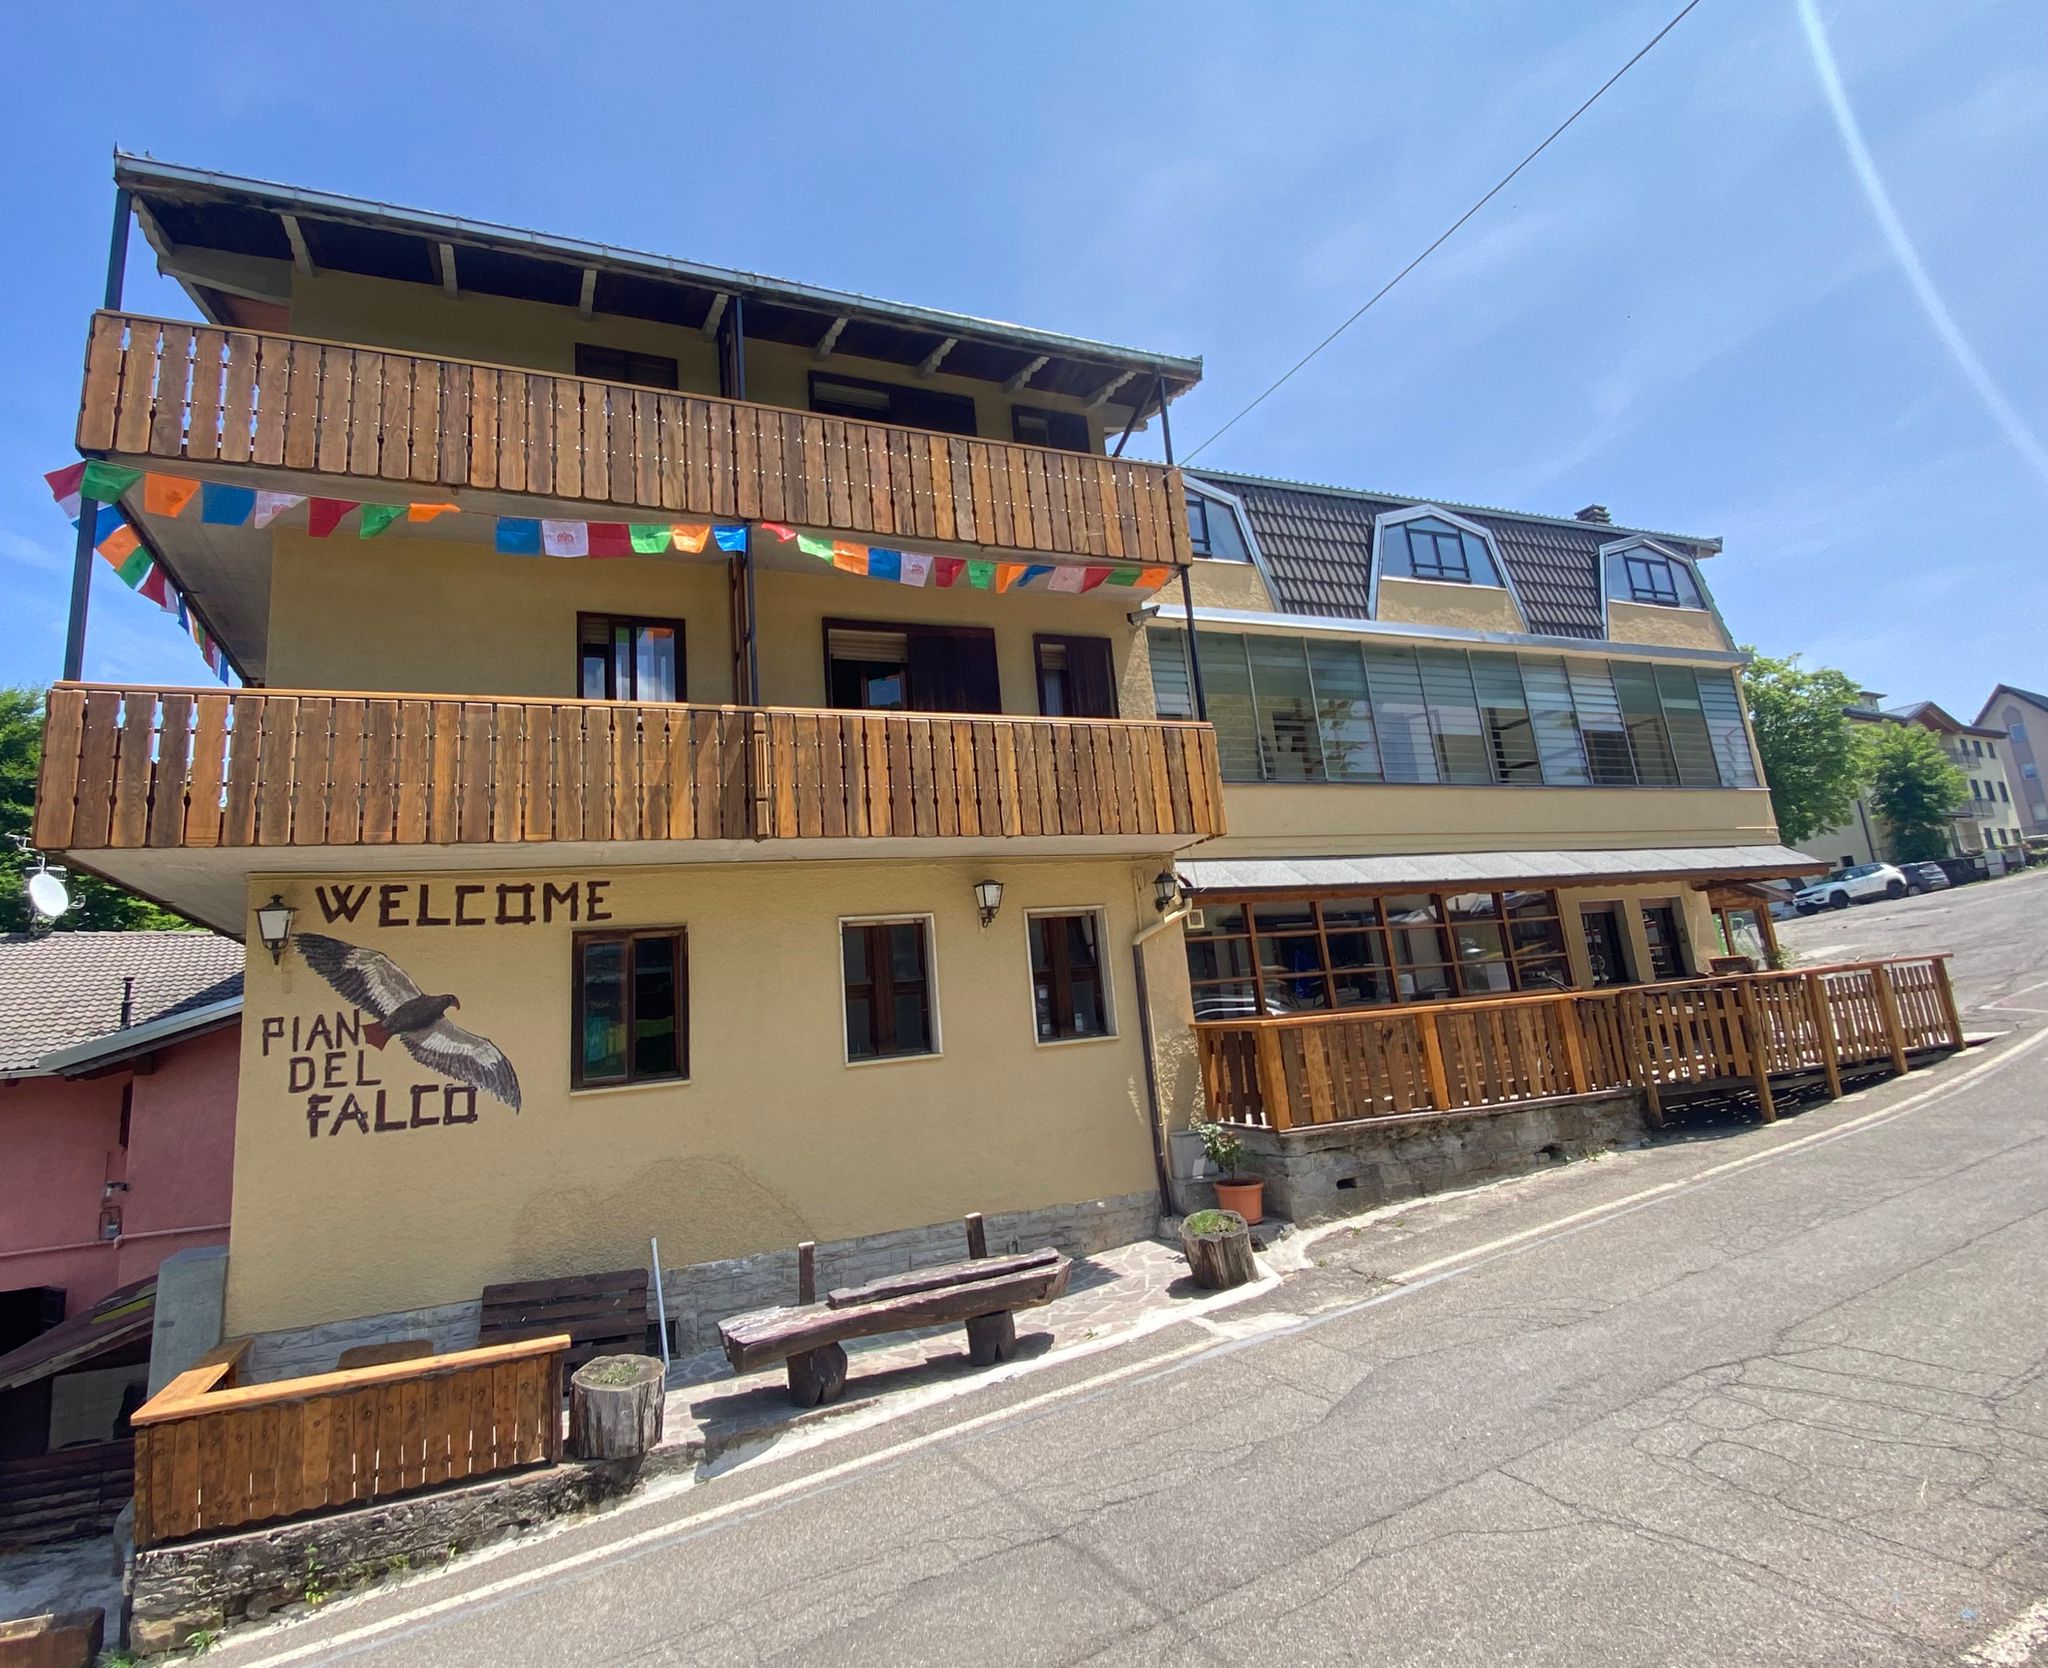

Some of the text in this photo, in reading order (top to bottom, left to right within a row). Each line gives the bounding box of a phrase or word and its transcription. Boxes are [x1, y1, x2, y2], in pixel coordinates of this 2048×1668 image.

[315, 881, 612, 927] WELCOME
[262, 1008, 360, 1056] PIAN
[288, 1050, 381, 1093] DEL
[306, 1083, 478, 1139] FALCO
